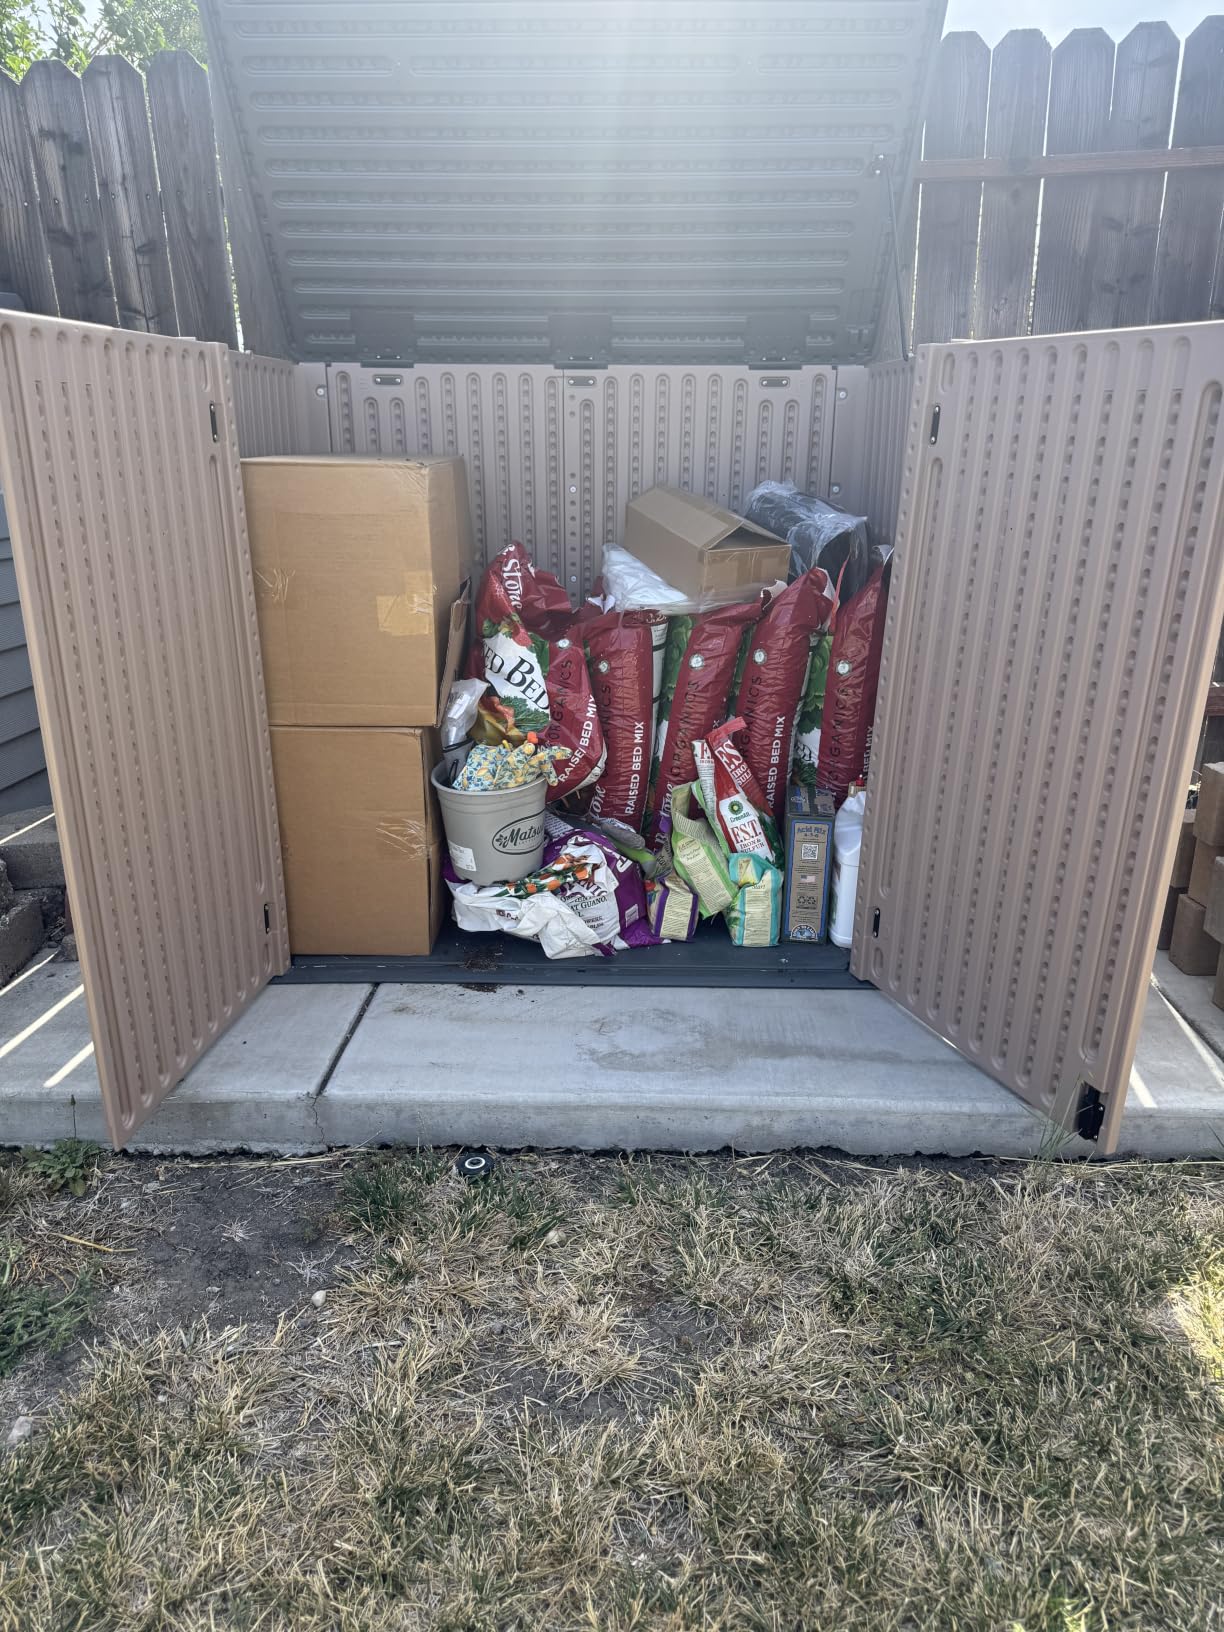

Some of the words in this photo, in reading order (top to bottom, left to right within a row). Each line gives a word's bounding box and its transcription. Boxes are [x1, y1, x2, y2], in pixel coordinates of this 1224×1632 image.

[503, 558, 523, 609] Stone
[635, 721, 645, 743] MIX
[774, 716, 786, 737] MIX
[558, 747, 586, 782] RAISE
[580, 721, 593, 747] BED
[632, 746, 643, 771] BED
[771, 739, 781, 764] BED
[625, 773, 640, 814] RAISED
[766, 766, 778, 809] RAISED
[730, 819, 762, 844] F.S.T.
[740, 839, 756, 850] IRON
